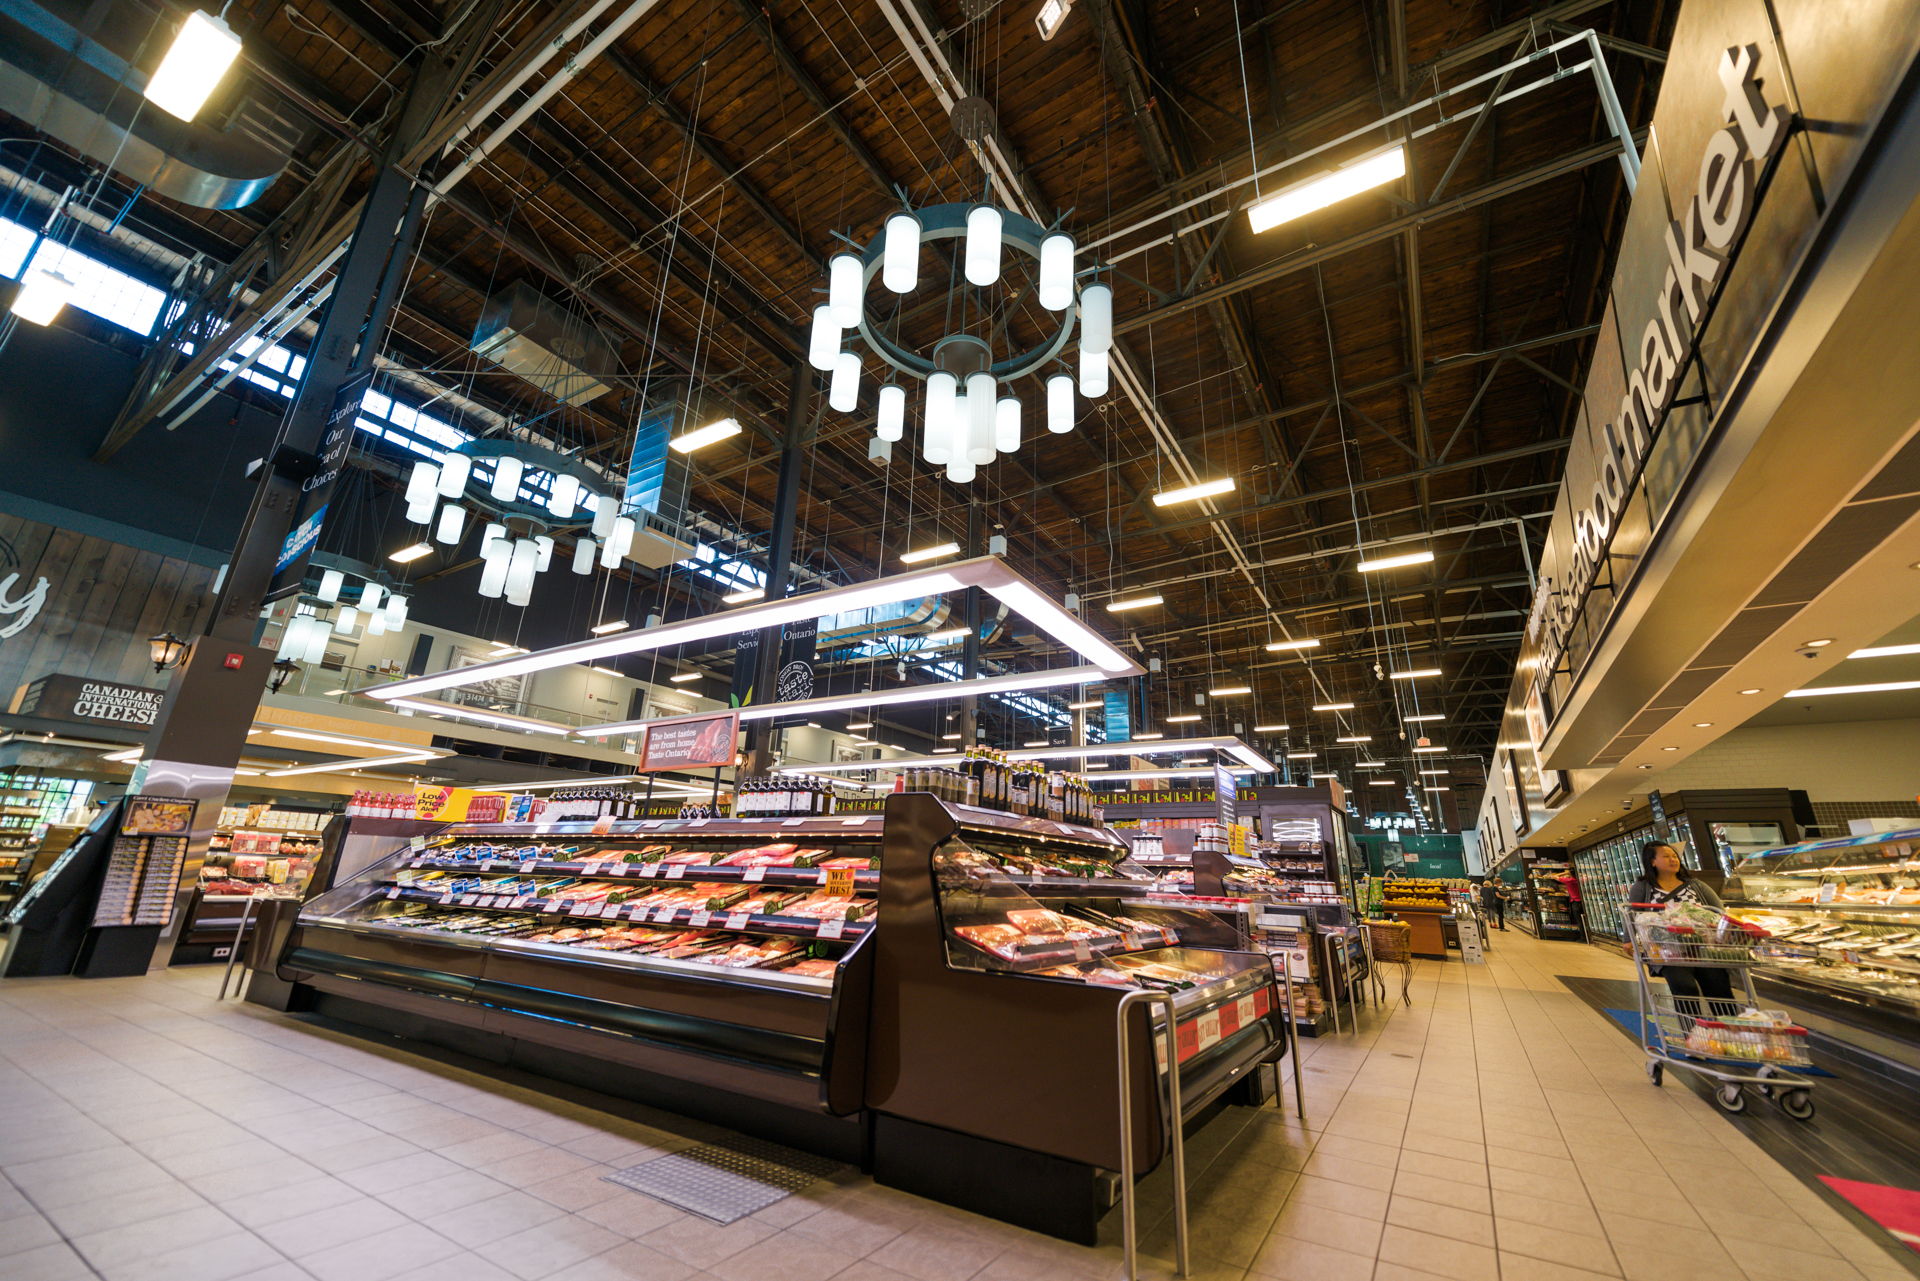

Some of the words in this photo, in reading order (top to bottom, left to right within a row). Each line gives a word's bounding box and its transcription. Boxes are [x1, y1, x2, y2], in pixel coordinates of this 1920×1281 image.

[1617, 42, 1790, 474] market
[326, 399, 362, 426] Explore
[325, 429, 344, 446] Our
[302, 467, 339, 492] Choices
[784, 627, 816, 641] Ontario
[82, 683, 155, 702] CANADIAN
[78, 692, 160, 711] INTERNATIONA
[651, 733, 663, 741] The
[663, 731, 676, 740] best
[678, 729, 697, 738] tastes
[661, 741, 676, 749] from
[648, 751, 664, 760] Taste
[422, 792, 444, 800] Low
[417, 799, 445, 808] Price
[831, 871, 846, 880] WE
[829, 886, 851, 894] BEST
